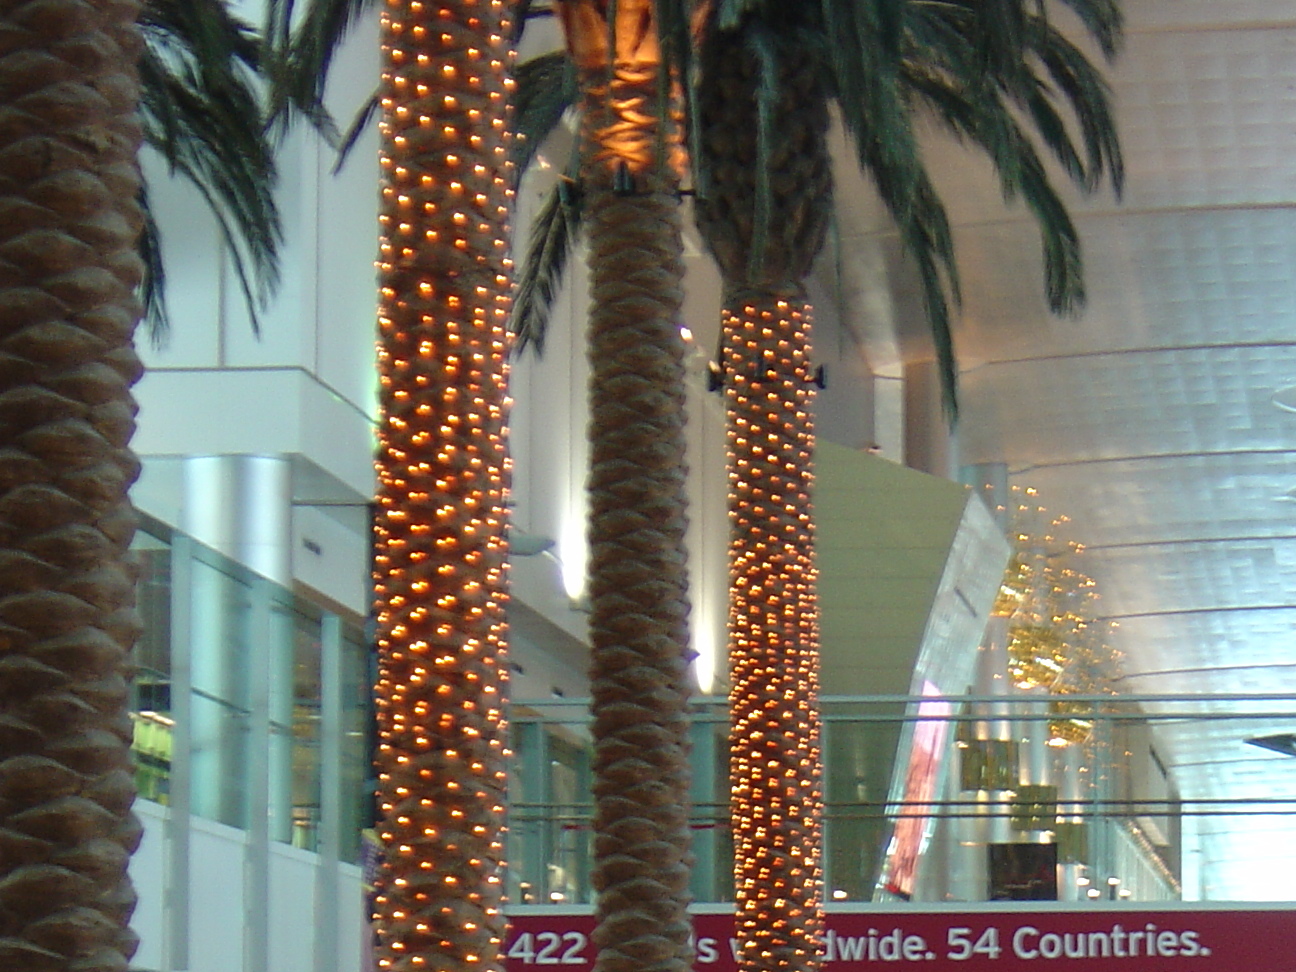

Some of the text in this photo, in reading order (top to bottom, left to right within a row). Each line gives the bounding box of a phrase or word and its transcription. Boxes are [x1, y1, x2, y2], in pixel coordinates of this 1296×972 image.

[507, 931, 588, 965] 422
[946, 926, 1003, 960] 54
[1012, 923, 1213, 959] Countries.
